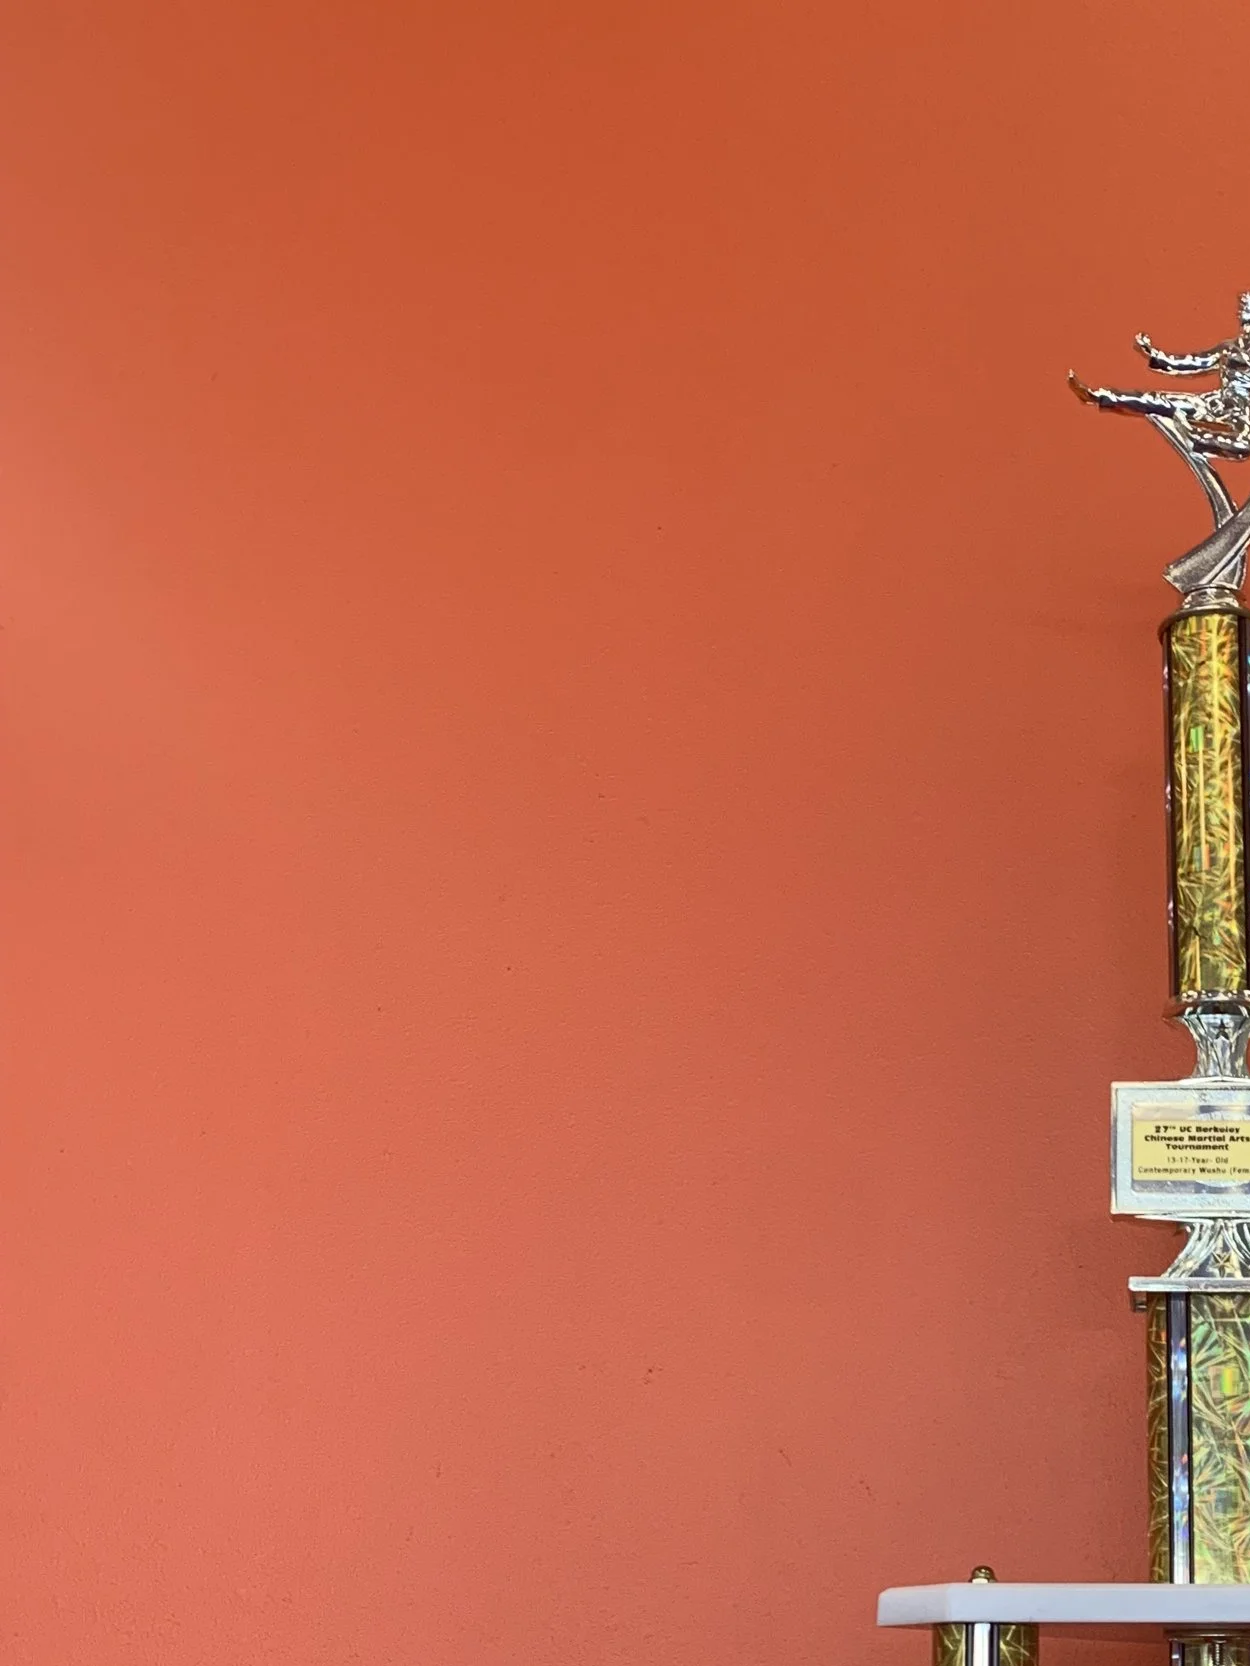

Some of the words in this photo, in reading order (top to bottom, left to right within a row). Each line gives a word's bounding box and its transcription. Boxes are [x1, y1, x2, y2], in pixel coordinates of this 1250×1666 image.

[1179, 1125, 1193, 1133] UC
[1195, 1125, 1240, 1134] Berkeley
[1144, 1134, 1185, 1142] Chinese
[1188, 1134, 1226, 1142] Martial
[1229, 1134, 1250, 1142] Arts
[1166, 1143, 1229, 1151] Tournament
[1215, 1156, 1229, 1164] Old
[1138, 1166, 1196, 1175] Contemporary
[1199, 1166, 1227, 1174] Wushu
